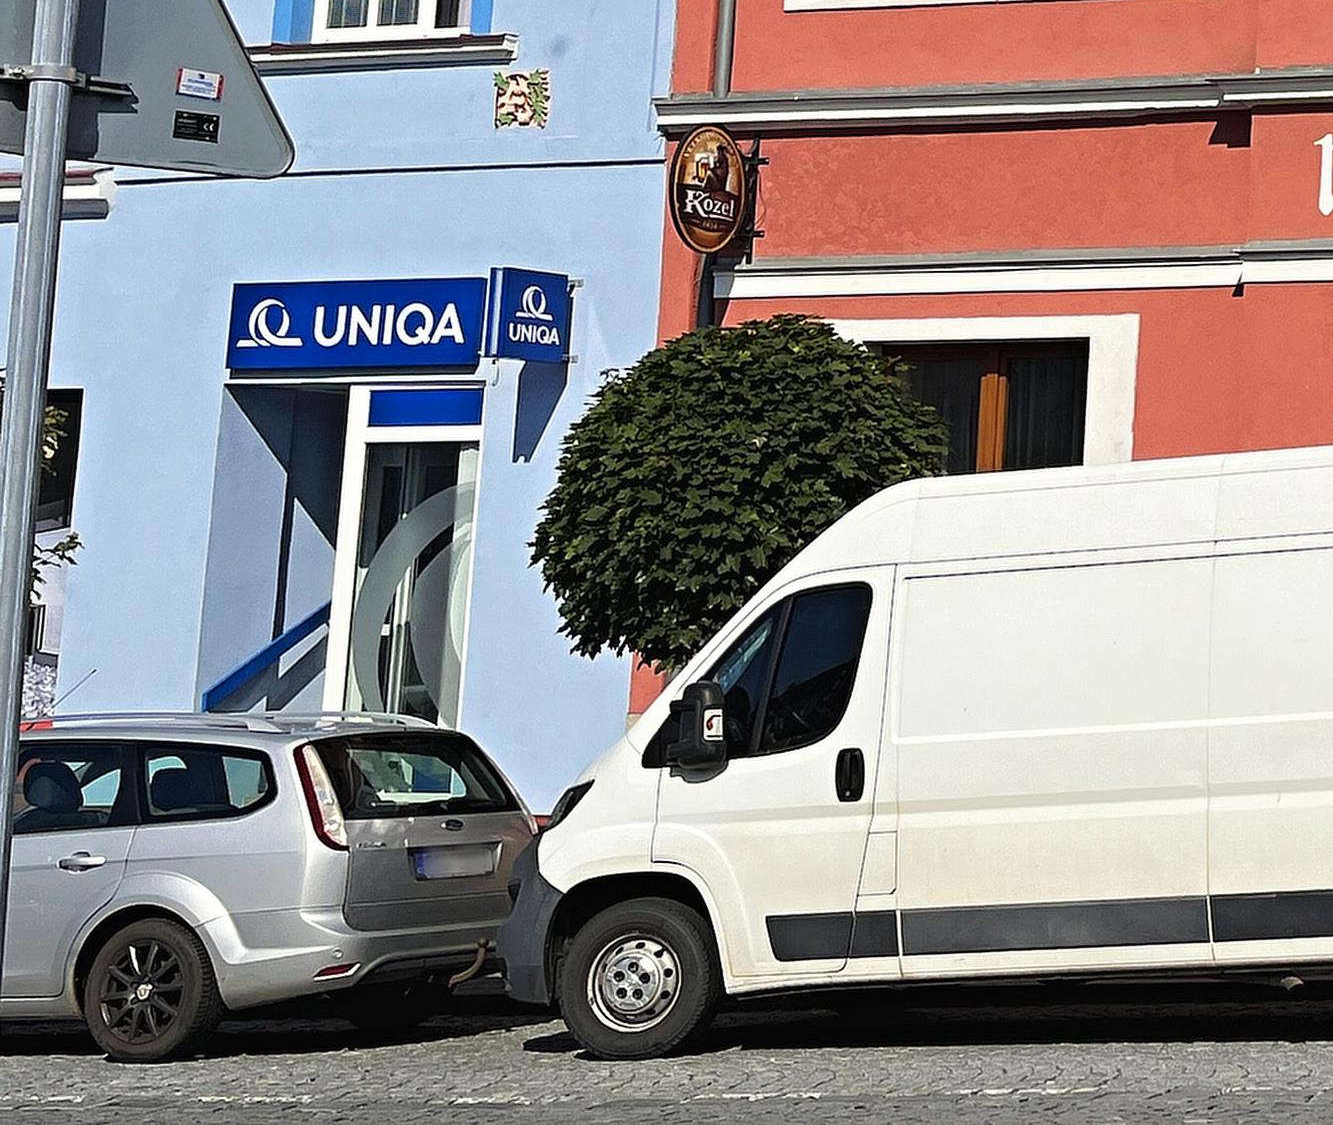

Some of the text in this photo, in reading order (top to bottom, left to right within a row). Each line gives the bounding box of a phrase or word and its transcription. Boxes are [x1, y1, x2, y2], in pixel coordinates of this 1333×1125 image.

[683, 189, 735, 221] Kozel
[313, 302, 465, 347] UNIQA
[508, 322, 561, 346] UNIQA
